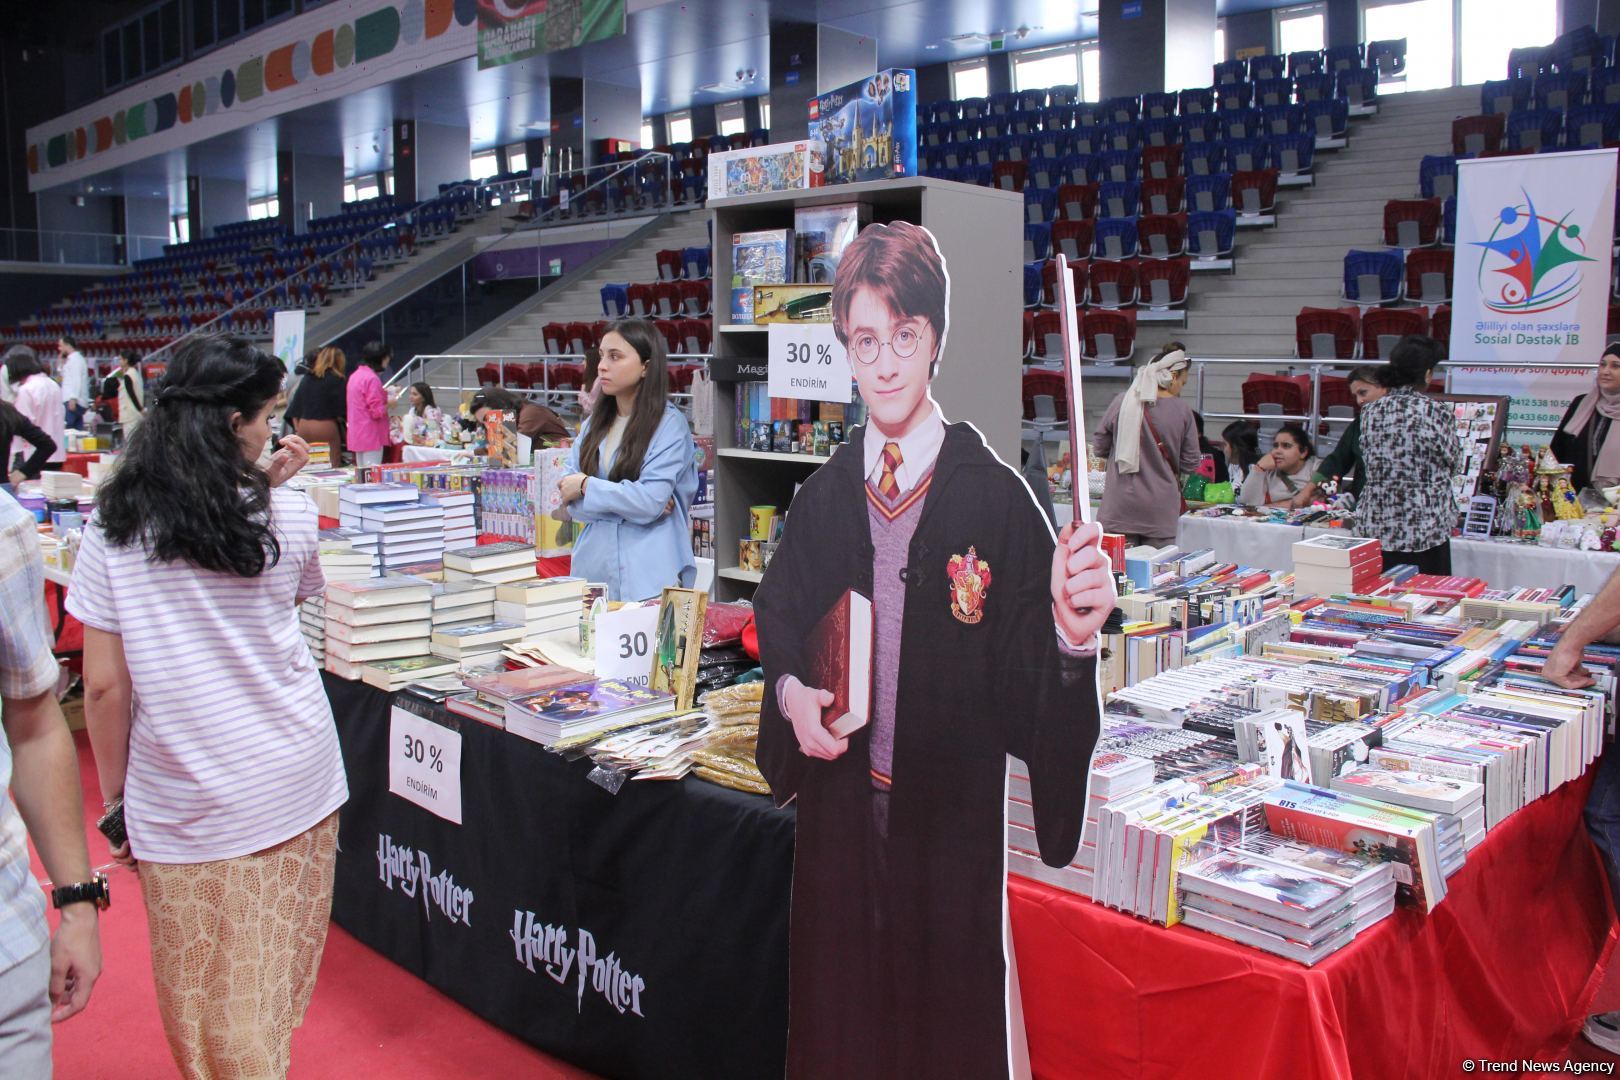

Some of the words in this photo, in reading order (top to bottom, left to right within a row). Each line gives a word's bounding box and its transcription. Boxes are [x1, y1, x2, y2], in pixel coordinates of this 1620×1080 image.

[1475, 321, 1508, 333] Əlilliyi
[1510, 321, 1534, 331] olan
[1537, 321, 1580, 333] şəxslərə
[1475, 333, 1512, 345] Sosial
[1516, 333, 1562, 345] Dəstək
[1566, 332, 1580, 345] İB
[786, 343, 811, 364] 30
[817, 343, 832, 365] %
[790, 377, 827, 389] ENDİRİM
[619, 631, 648, 659] 30
[404, 734, 425, 764] 30
[429, 744, 444, 774] %
[406, 775, 438, 800] ENDİRİM
[1278, 799, 1298, 809] BTS
[376, 833, 420, 899] Harry
[418, 849, 474, 928] Potter
[508, 909, 576, 985] Harry
[576, 927, 645, 1018] Potter
